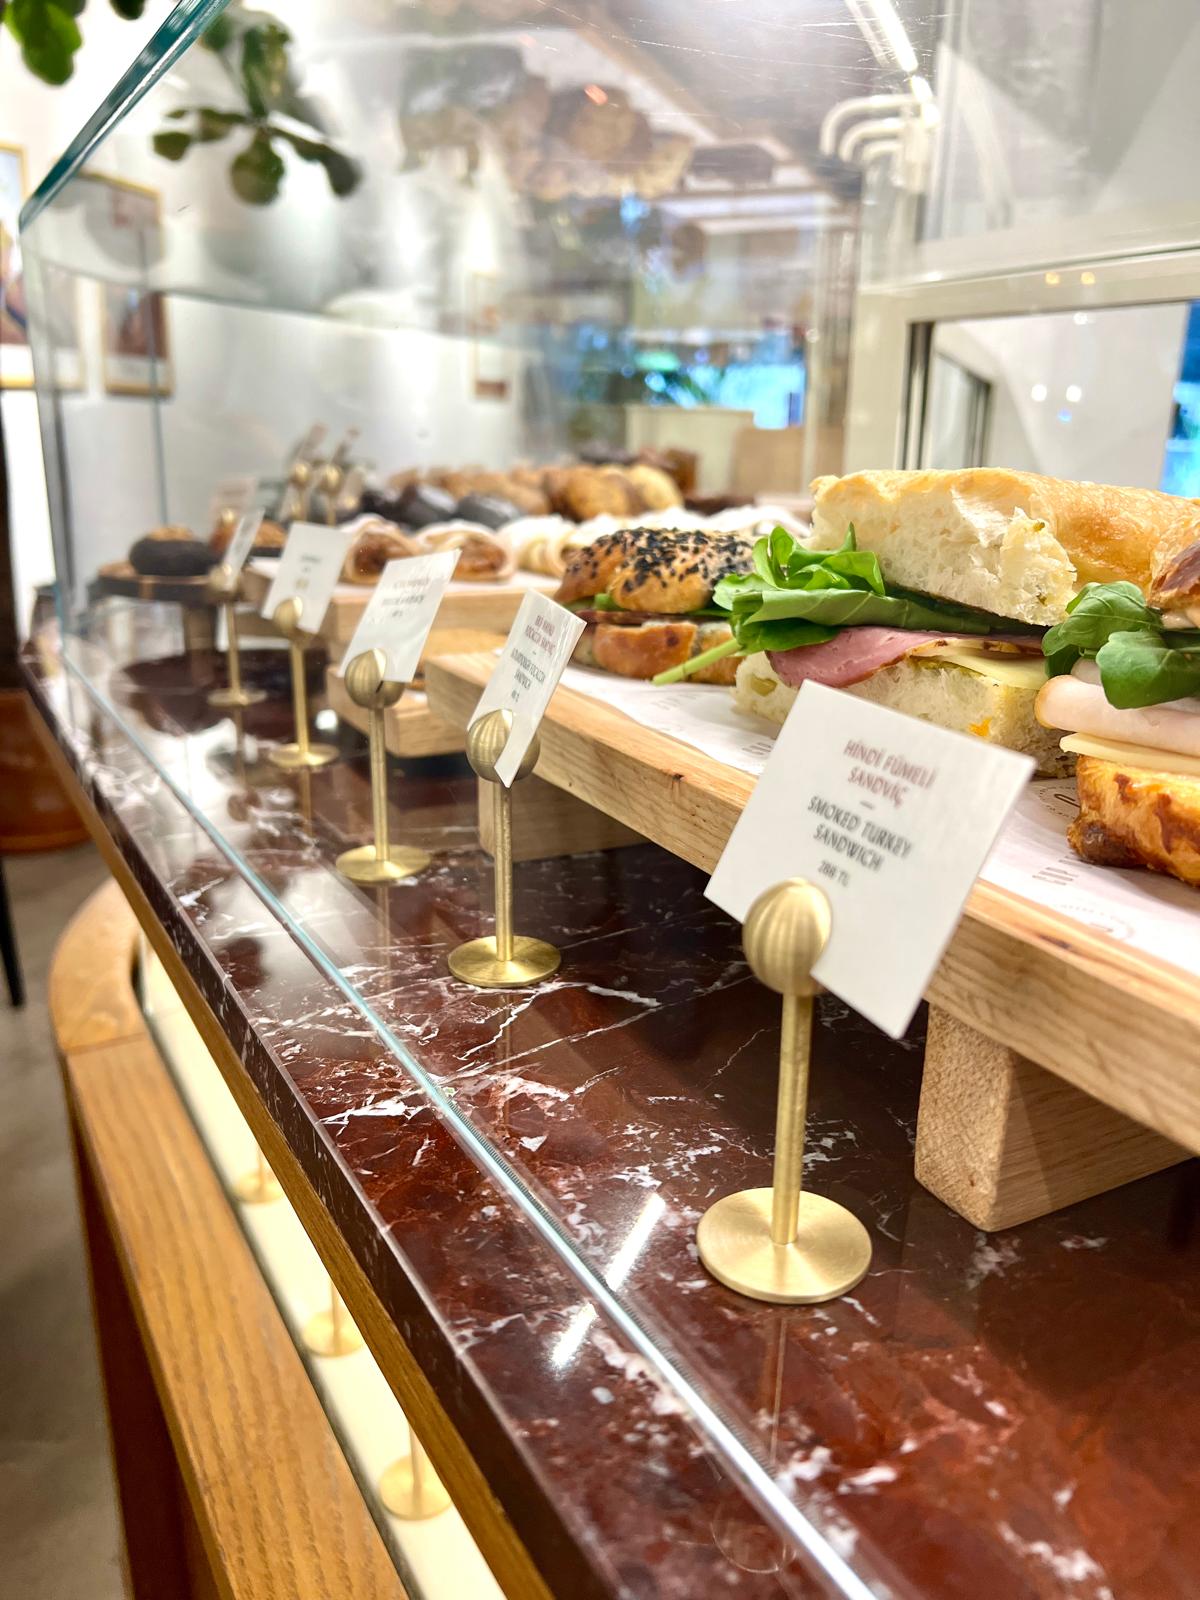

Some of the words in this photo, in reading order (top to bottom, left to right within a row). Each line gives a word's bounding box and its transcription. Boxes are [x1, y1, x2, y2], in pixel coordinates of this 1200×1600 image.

[807, 795, 861, 832] SMOKED
[861, 820, 912, 859] TURKEY
[813, 823, 884, 872] SANDWICH
